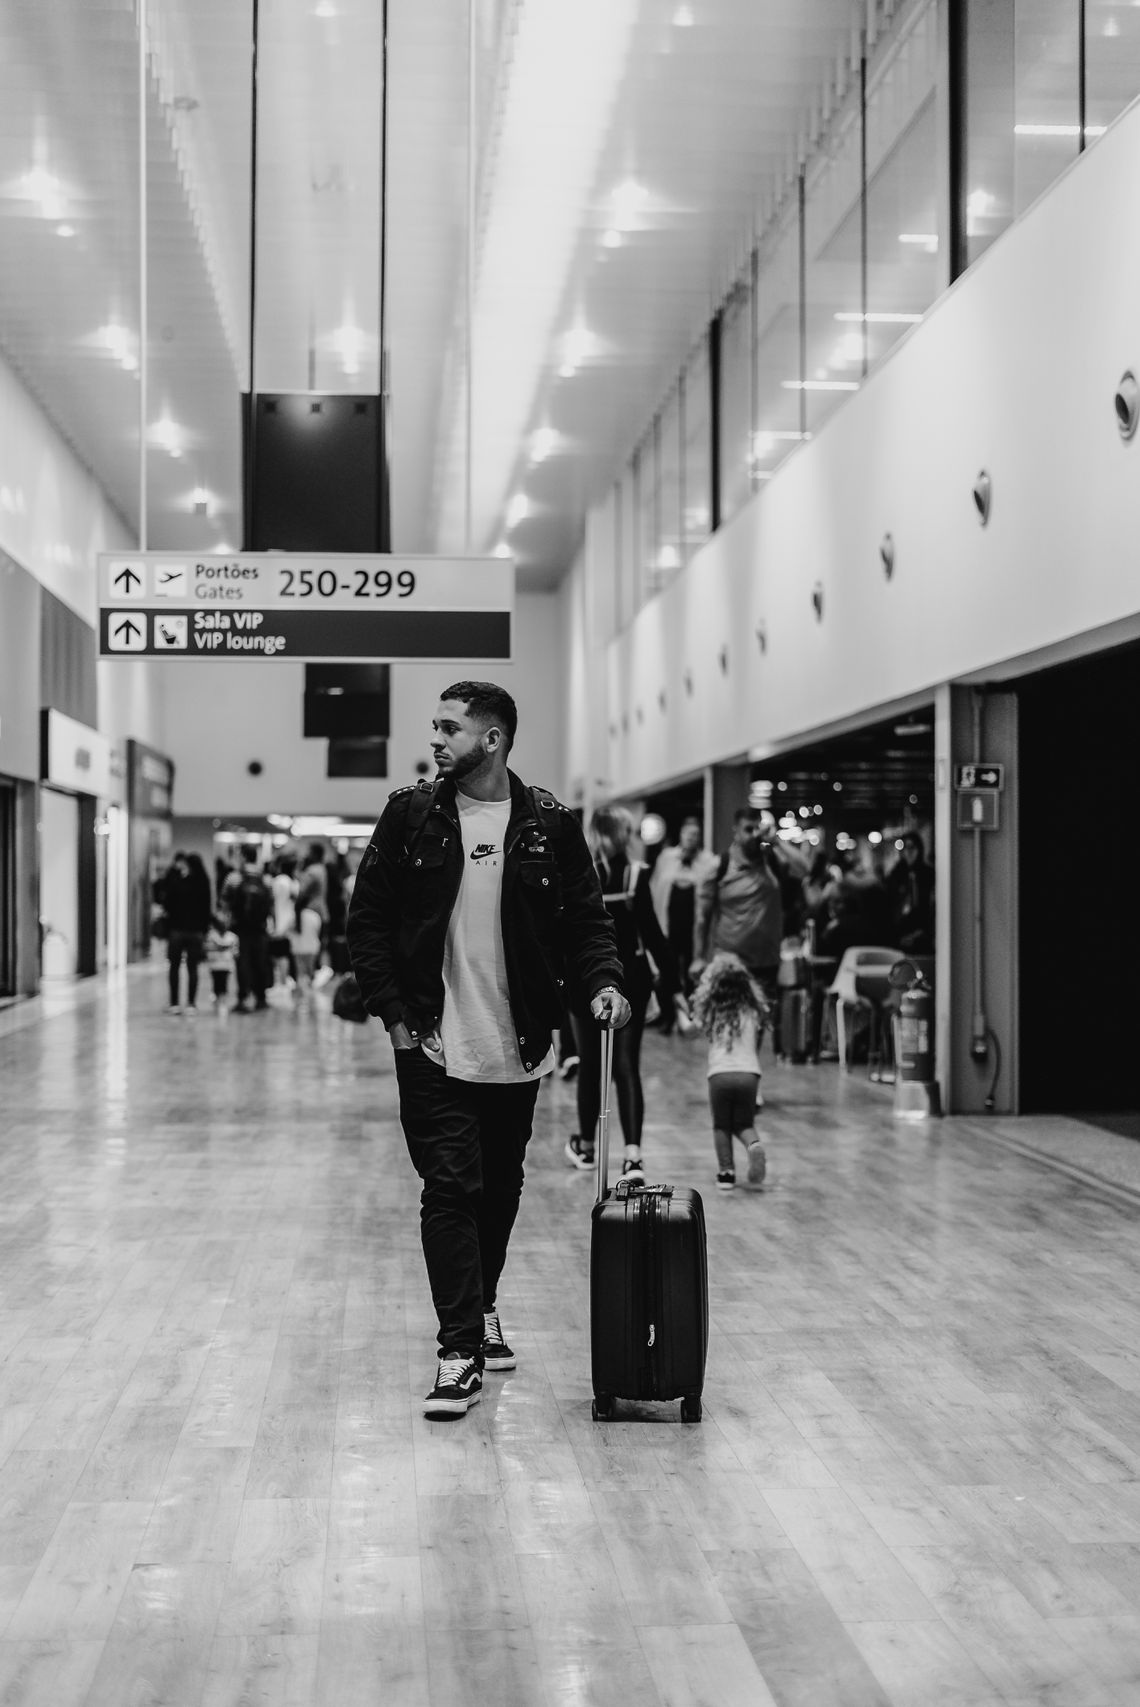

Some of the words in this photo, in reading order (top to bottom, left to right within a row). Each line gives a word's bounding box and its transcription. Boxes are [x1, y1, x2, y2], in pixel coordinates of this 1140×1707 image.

[195, 563, 259, 579] Portões
[195, 583, 243, 600] Gates
[279, 570, 416, 598] 250-299
[194, 611, 231, 629] Sala
[233, 612, 263, 630] VIP
[194, 632, 224, 649] VIP
[227, 632, 286, 654] lounge
[475, 844, 496, 854] NIKE
